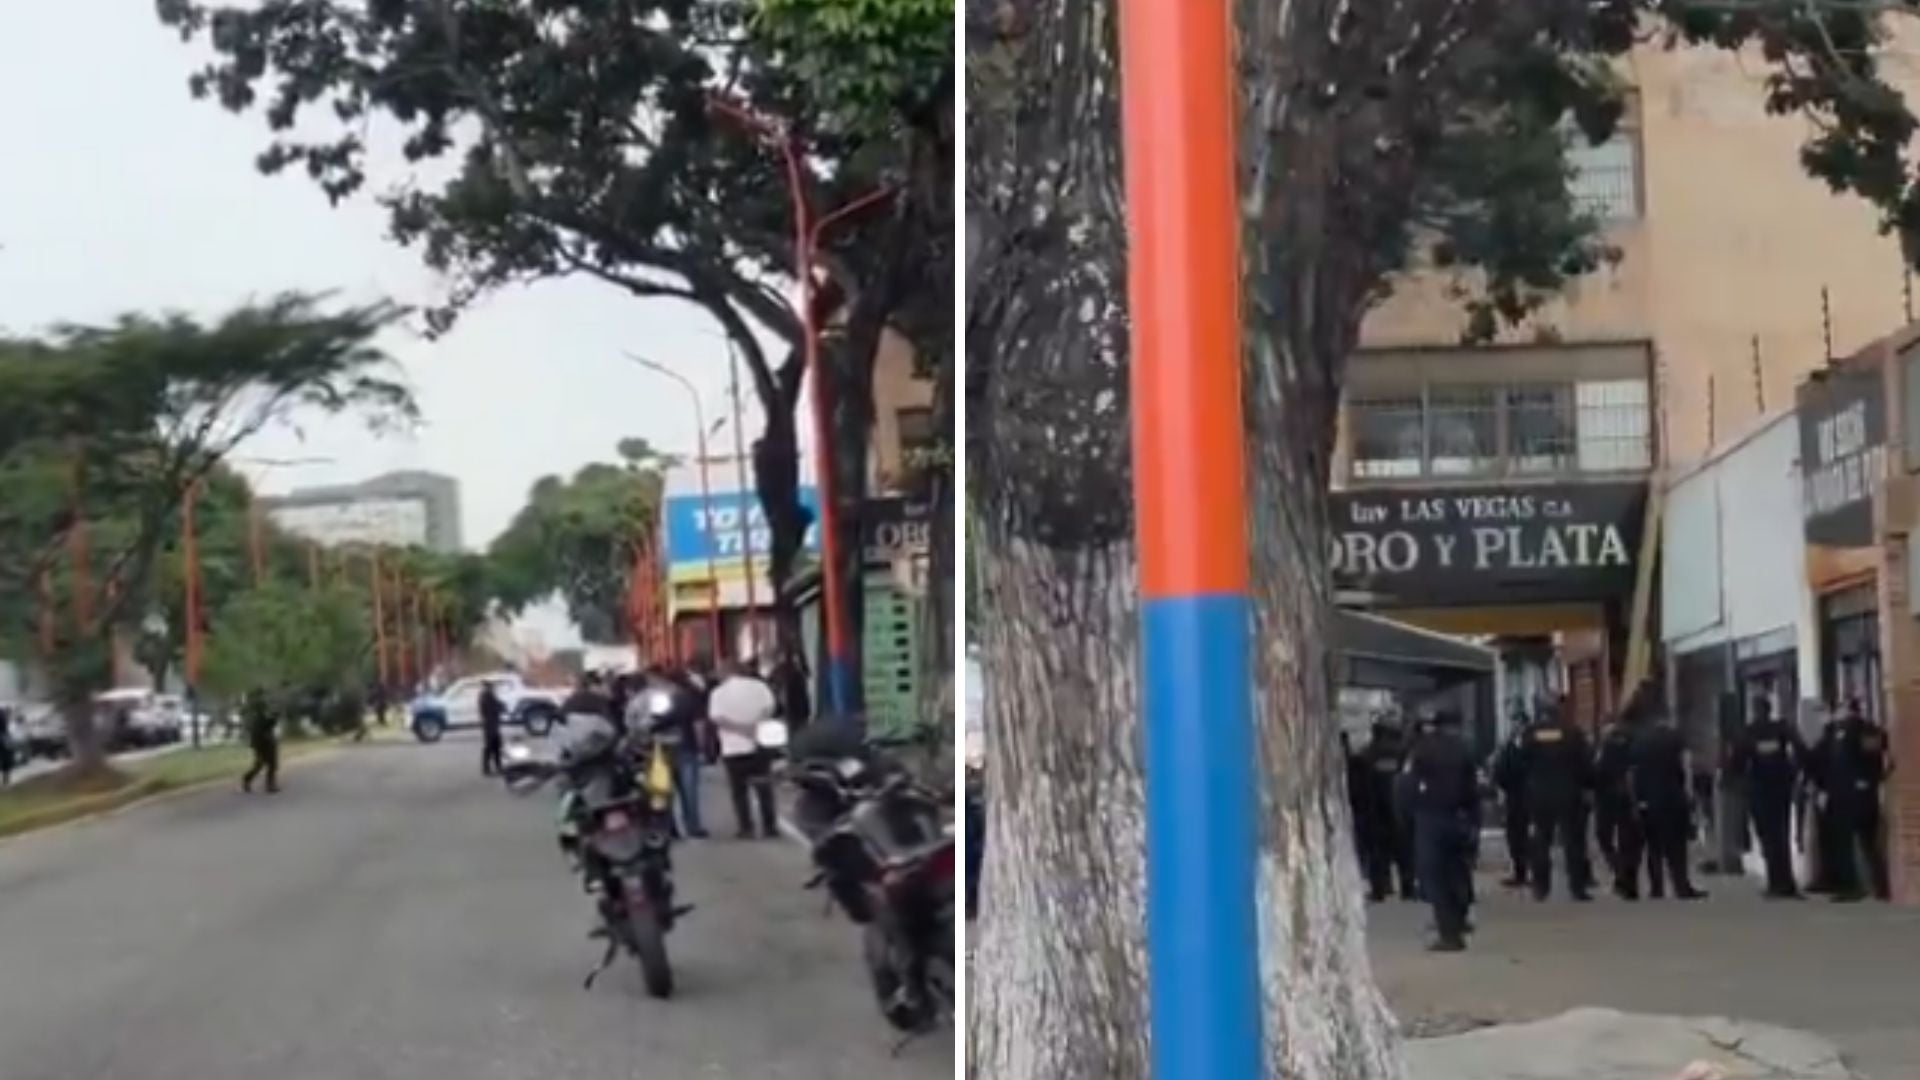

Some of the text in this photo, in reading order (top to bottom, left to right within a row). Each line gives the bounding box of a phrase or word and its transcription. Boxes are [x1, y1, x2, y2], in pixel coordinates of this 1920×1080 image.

[1401, 498, 1446, 521] LAS
[1455, 496, 1536, 520] VEGAS
[1434, 533, 1457, 567] Y
[1472, 522, 1630, 569] PLATA
